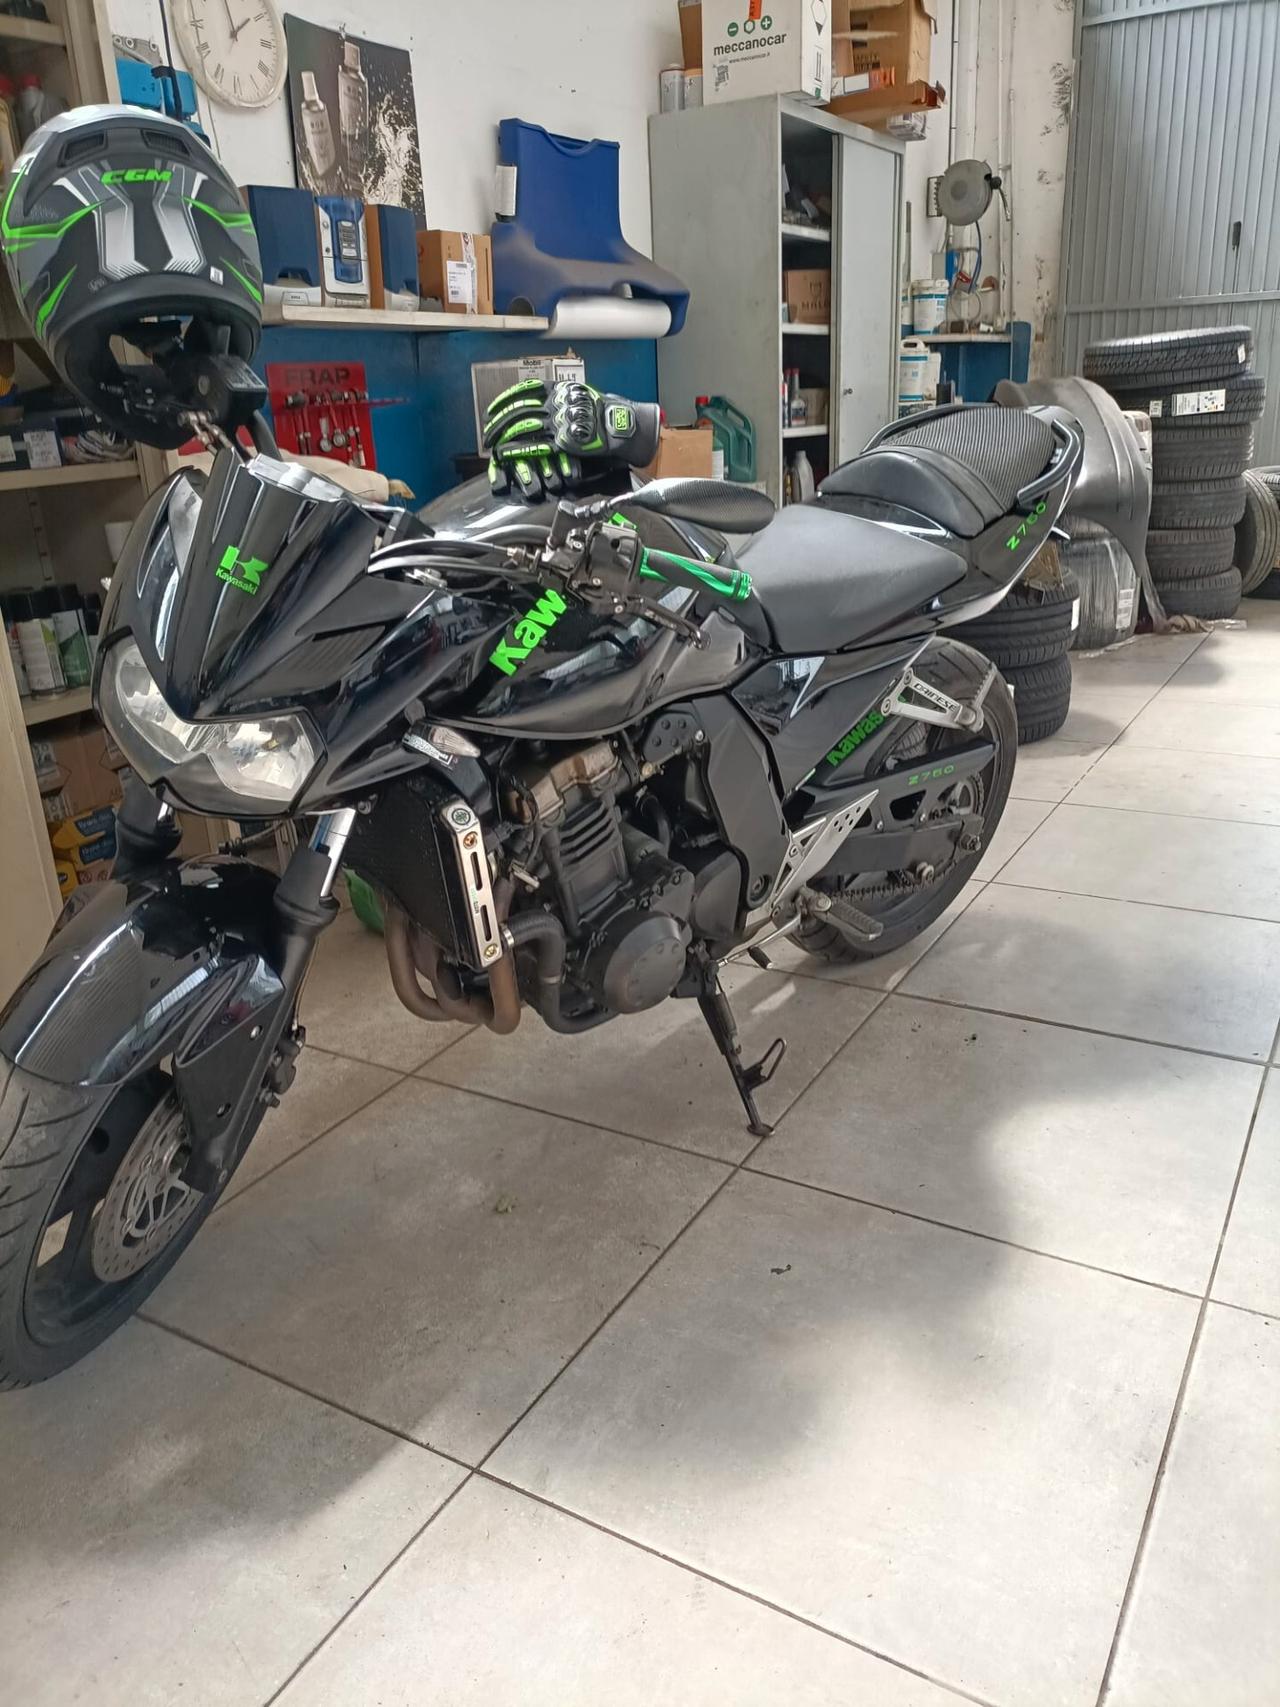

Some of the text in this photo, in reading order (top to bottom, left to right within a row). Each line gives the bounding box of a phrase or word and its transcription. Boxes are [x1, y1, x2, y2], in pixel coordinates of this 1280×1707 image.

[713, 33, 787, 56] meccanocar
[101, 168, 172, 184] CGM
[215, 567, 258, 596] Kawasaki
[826, 709, 885, 767] Kawas
